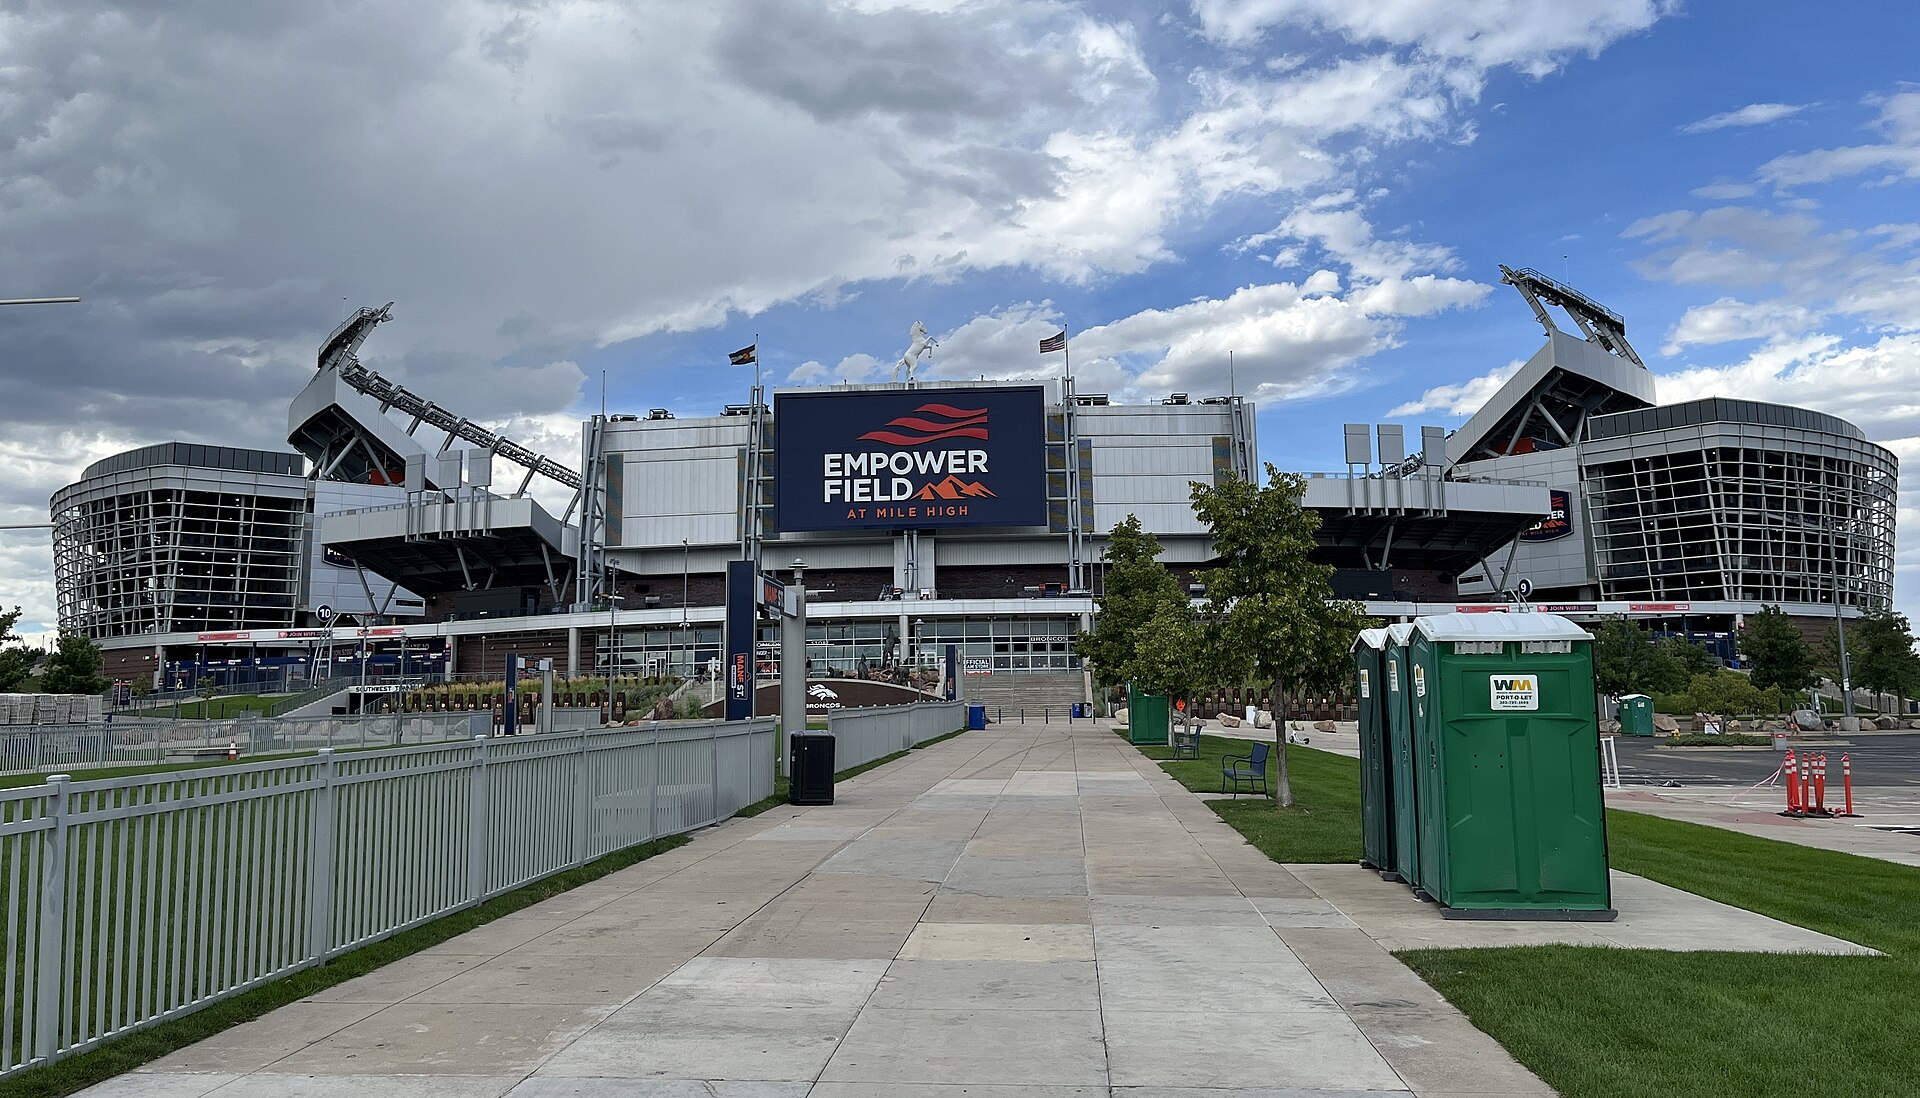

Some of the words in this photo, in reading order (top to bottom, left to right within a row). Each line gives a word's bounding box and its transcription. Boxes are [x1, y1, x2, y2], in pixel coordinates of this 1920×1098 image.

[824, 449, 988, 477] EMPOWER
[824, 477, 914, 503] FIELD
[847, 509, 867, 519] AT
[876, 507, 917, 518] MILE
[927, 505, 969, 517] HIGH
[1520, 584, 1527, 593] 9
[319, 608, 331, 618] 10
[737, 655, 745, 683] MANE
[736, 684, 744, 698] ST.
[1493, 679, 1533, 691] WM
